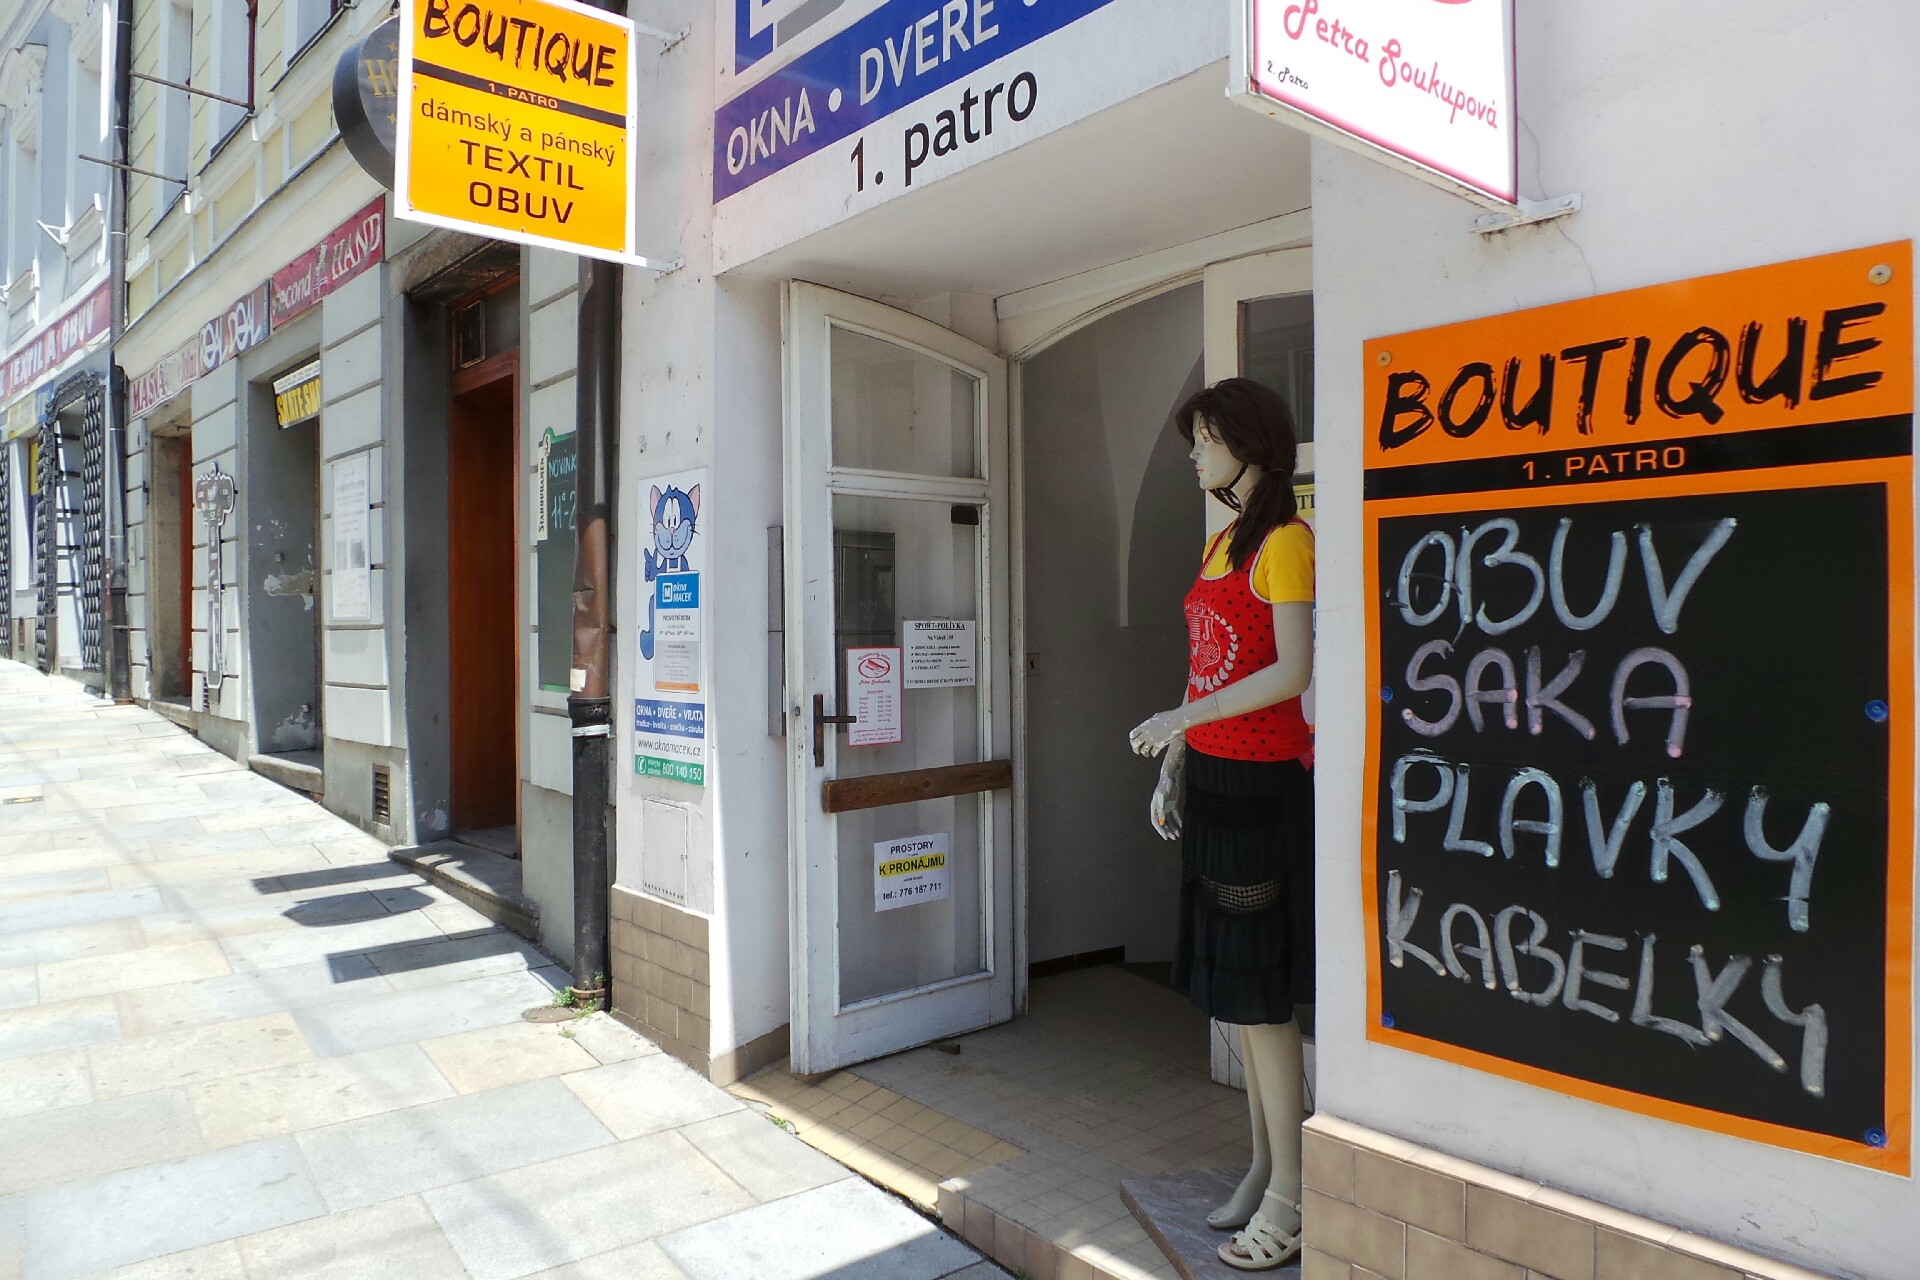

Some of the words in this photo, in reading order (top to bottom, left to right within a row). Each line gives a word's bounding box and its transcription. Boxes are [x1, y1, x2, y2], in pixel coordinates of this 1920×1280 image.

[423, 0, 617, 87] BOUTIQUE
[1267, 60, 1276, 75] 2.
[1278, 66, 1309, 90] Patro
[1282, 0, 1370, 63] Petra
[1378, 38, 1498, 129] Soukupová
[488, 82, 503, 95] 1.
[508, 87, 558, 109] PATRO
[420, 98, 512, 142] dámský
[519, 126, 533, 143] a
[541, 132, 616, 167] pánský
[726, 86, 817, 175] OKNA
[849, 136, 884, 193] 1.
[904, 71, 1038, 187] patro
[459, 139, 585, 191] TEXTIL
[469, 181, 574, 224] OBUV
[331, 212, 381, 280] HAND
[1378, 301, 1888, 452] BOUTIQUE
[1521, 461, 1551, 481] 1.
[1565, 446, 1686, 477] PATRO
[1397, 516, 1738, 635] OBUV
[636, 704, 652, 717] OKNA
[683, 709, 704, 722] VRATA
[1400, 638, 1692, 758] SAKA
[675, 765, 688, 779] 140
[689, 767, 702, 781] 150
[879, 865, 887, 876] K
[889, 856, 945, 874] PRONÁJMU
[890, 840, 934, 855] PROSTORY
[1389, 748, 1831, 932] PLAVKY
[899, 887, 913, 898] 776
[914, 884, 928, 894] 187
[929, 882, 942, 892] 711
[1386, 869, 1828, 1097] KABELKY
